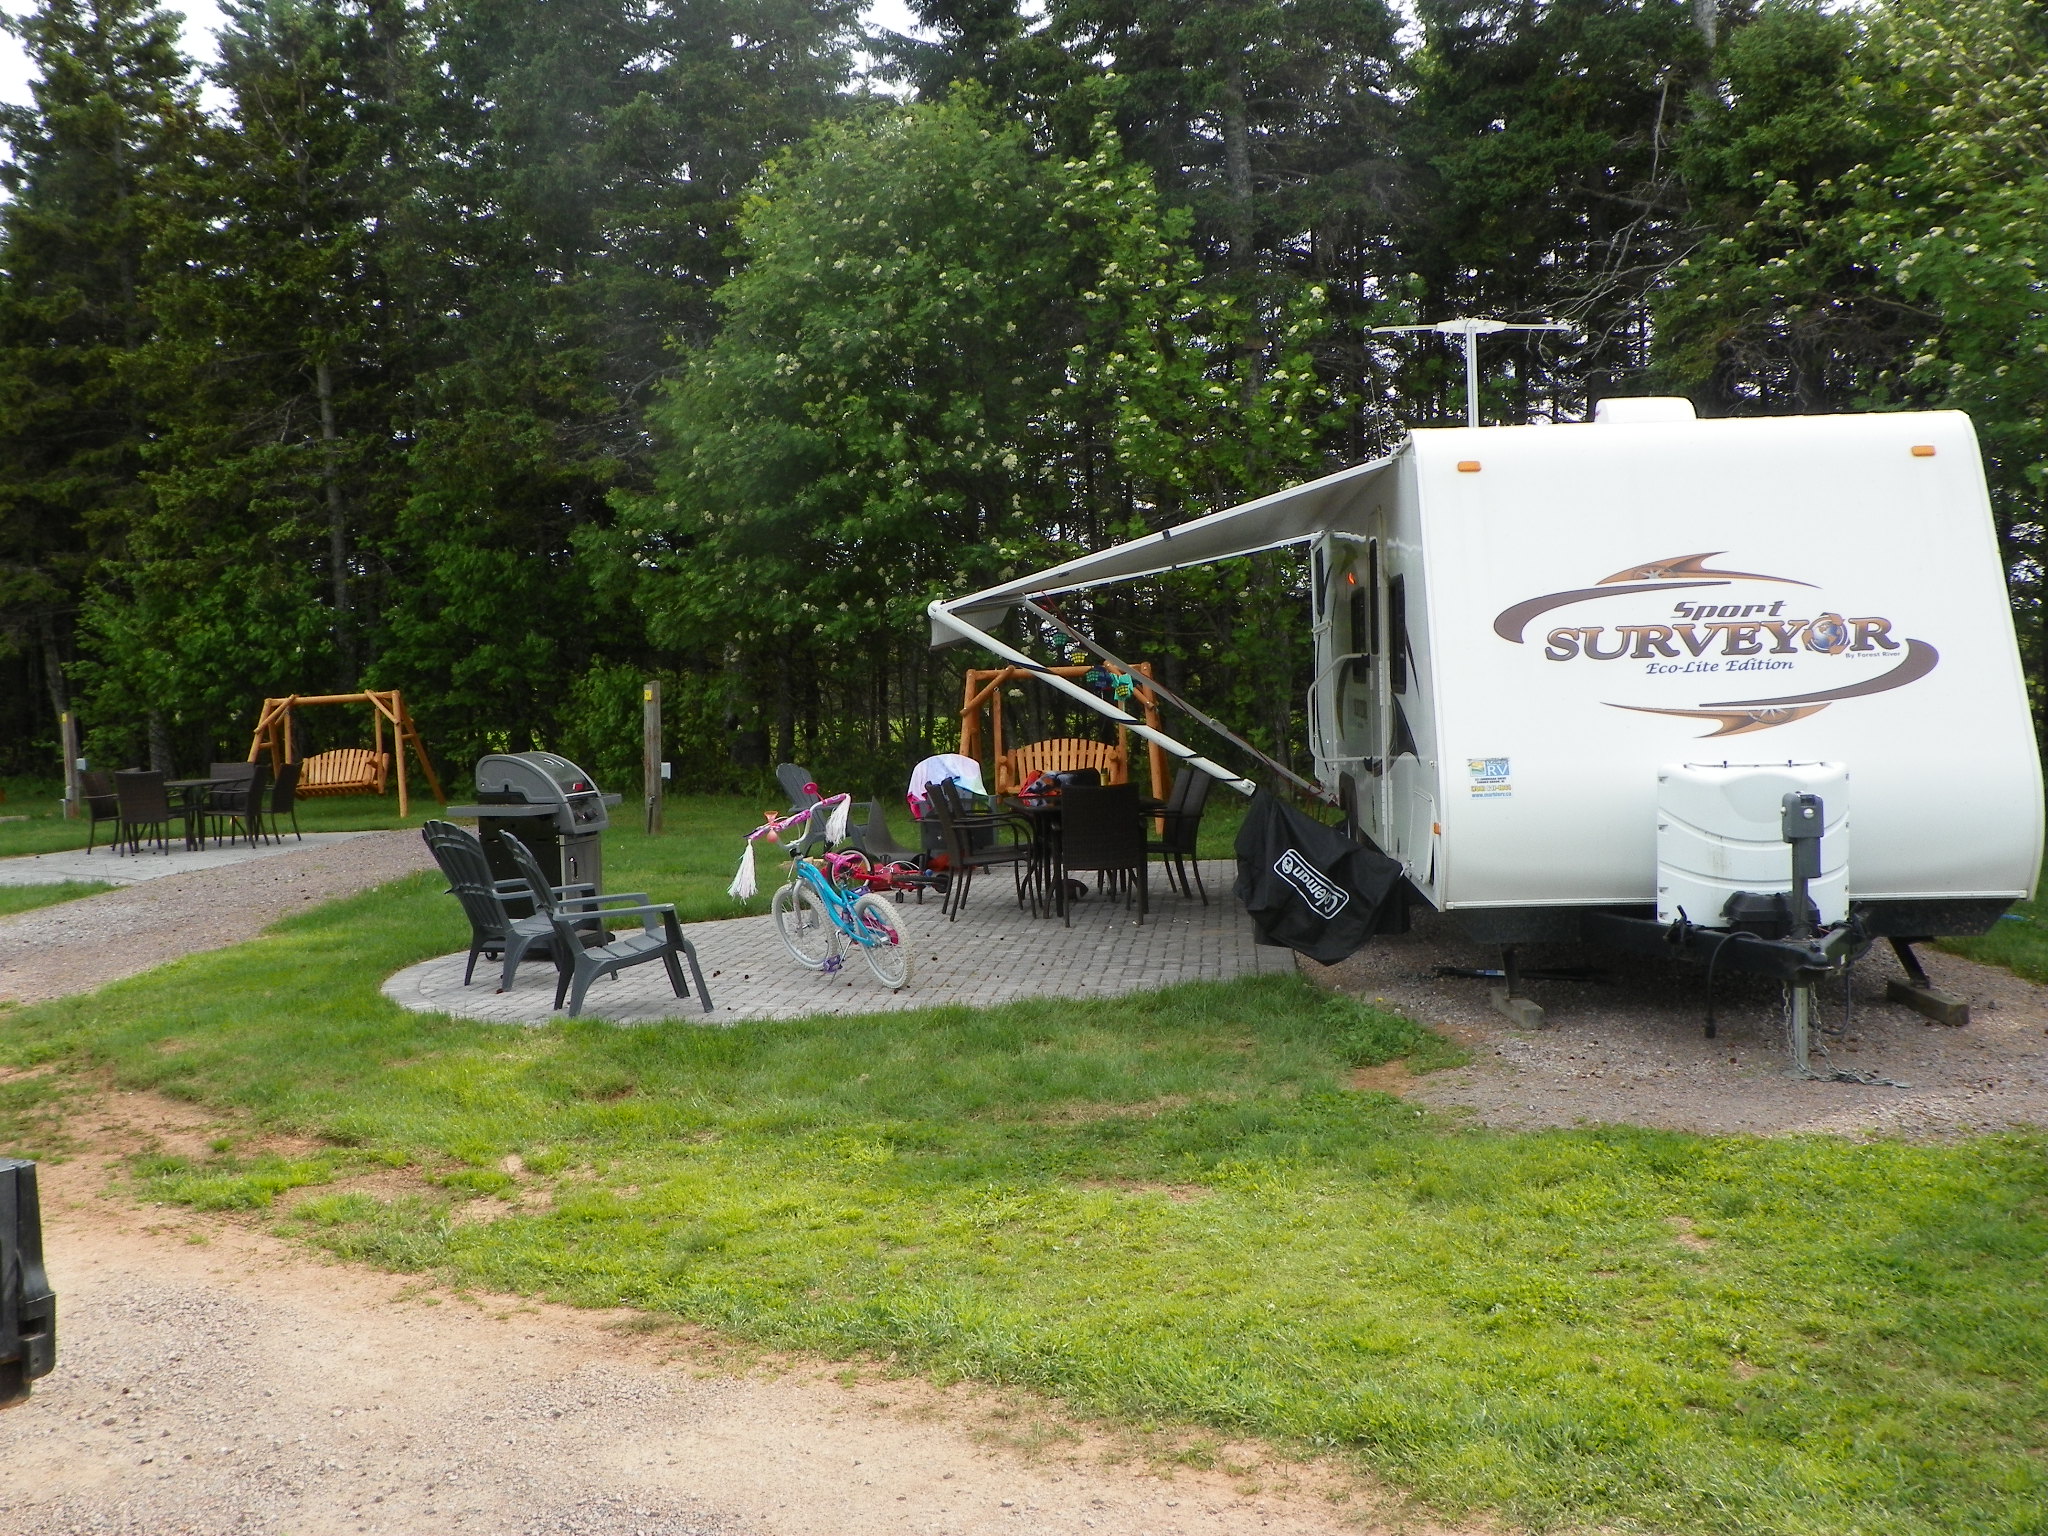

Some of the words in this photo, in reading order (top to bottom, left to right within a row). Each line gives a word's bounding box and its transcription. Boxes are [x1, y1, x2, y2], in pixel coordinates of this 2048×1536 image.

[1670, 600, 1787, 621] Sport
[1545, 612, 1900, 662] SURVEYOR
[1646, 660, 1719, 675] Eco-Lite
[1726, 658, 1794, 672] Edition
[1487, 765, 1508, 776] RV
[1292, 866, 1338, 913] Coleman
